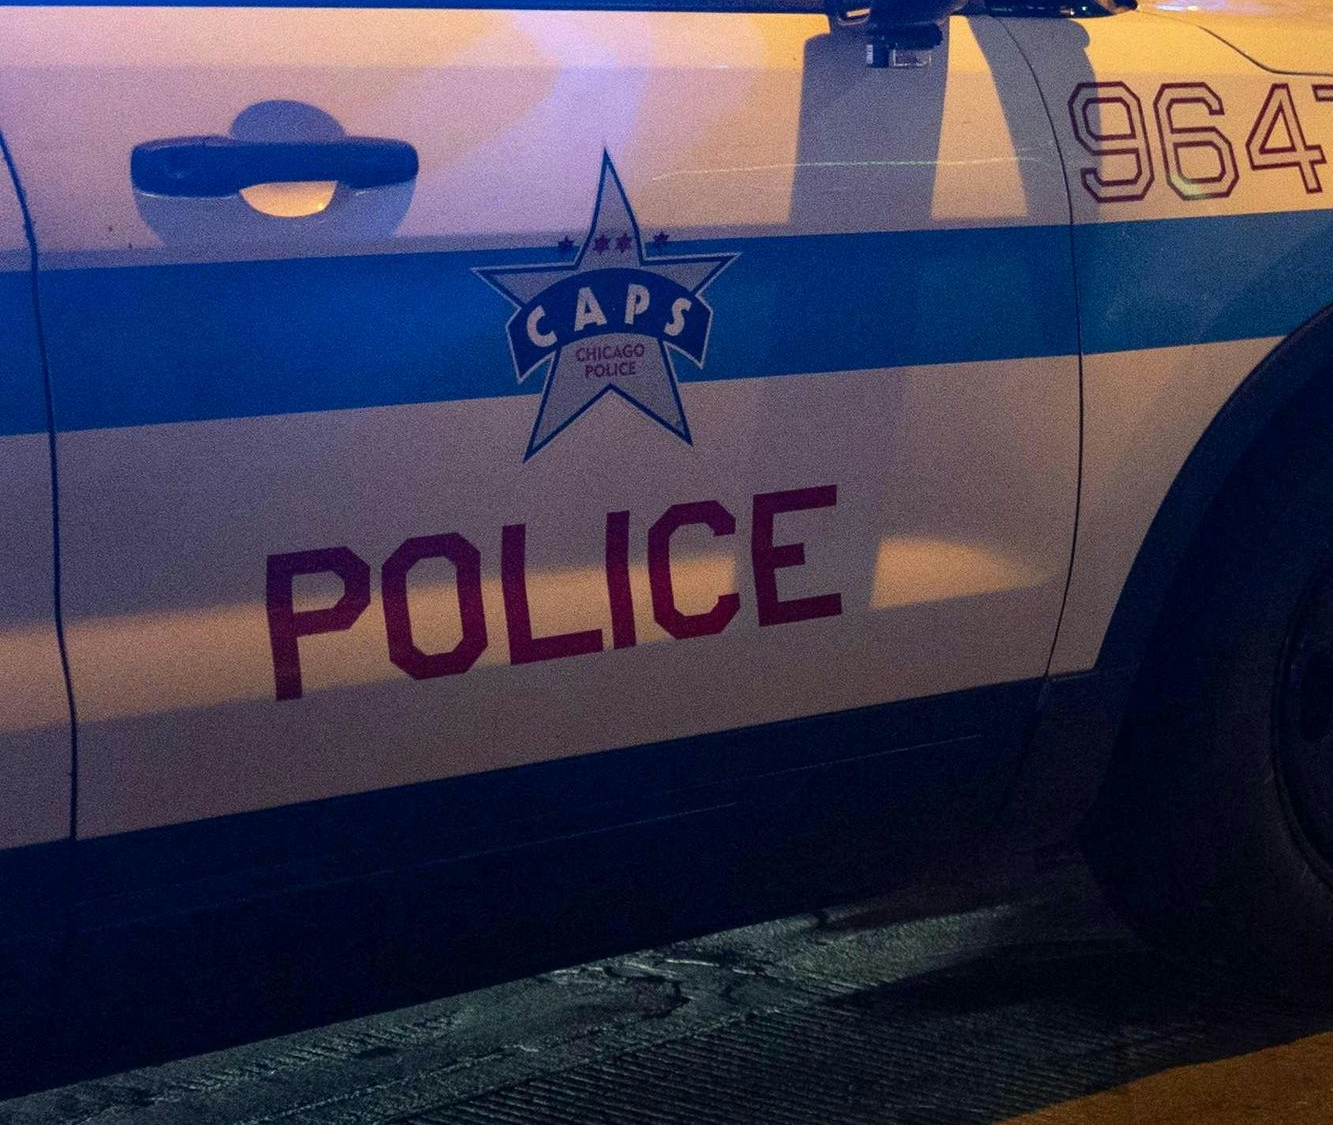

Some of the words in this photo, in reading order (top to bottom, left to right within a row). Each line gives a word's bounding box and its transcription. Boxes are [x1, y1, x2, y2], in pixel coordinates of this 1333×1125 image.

[526, 283, 692, 348] CAPS
[575, 343, 645, 362] CHICAGO
[584, 362, 636, 379] POLICE
[265, 484, 842, 701] POLICE
